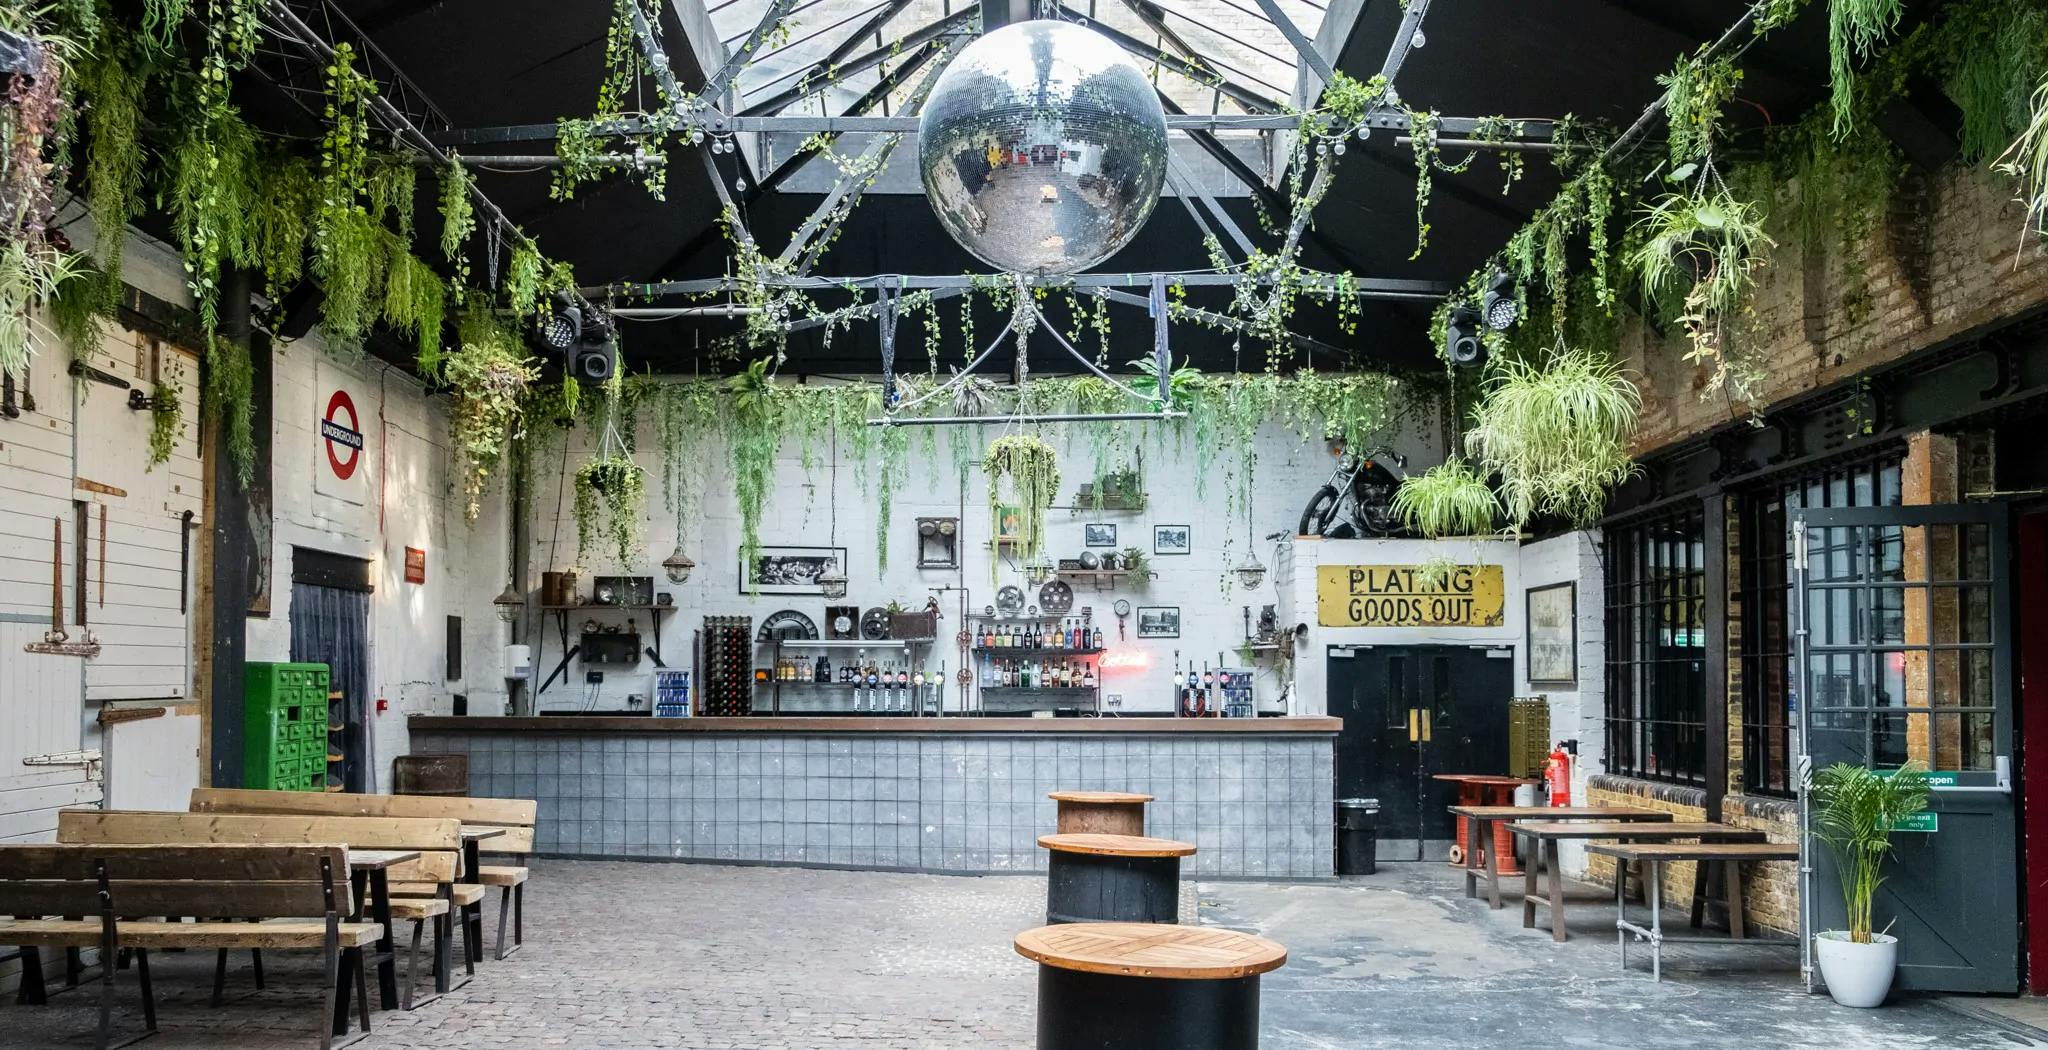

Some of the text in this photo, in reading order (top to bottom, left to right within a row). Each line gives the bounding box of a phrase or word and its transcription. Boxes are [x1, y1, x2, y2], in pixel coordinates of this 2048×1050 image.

[322, 424, 361, 447] UNDERGROUND
[1349, 569, 1473, 592] PLATNG
[1349, 598, 1475, 622] GOODS OUT
[1929, 777, 1953, 785] open
